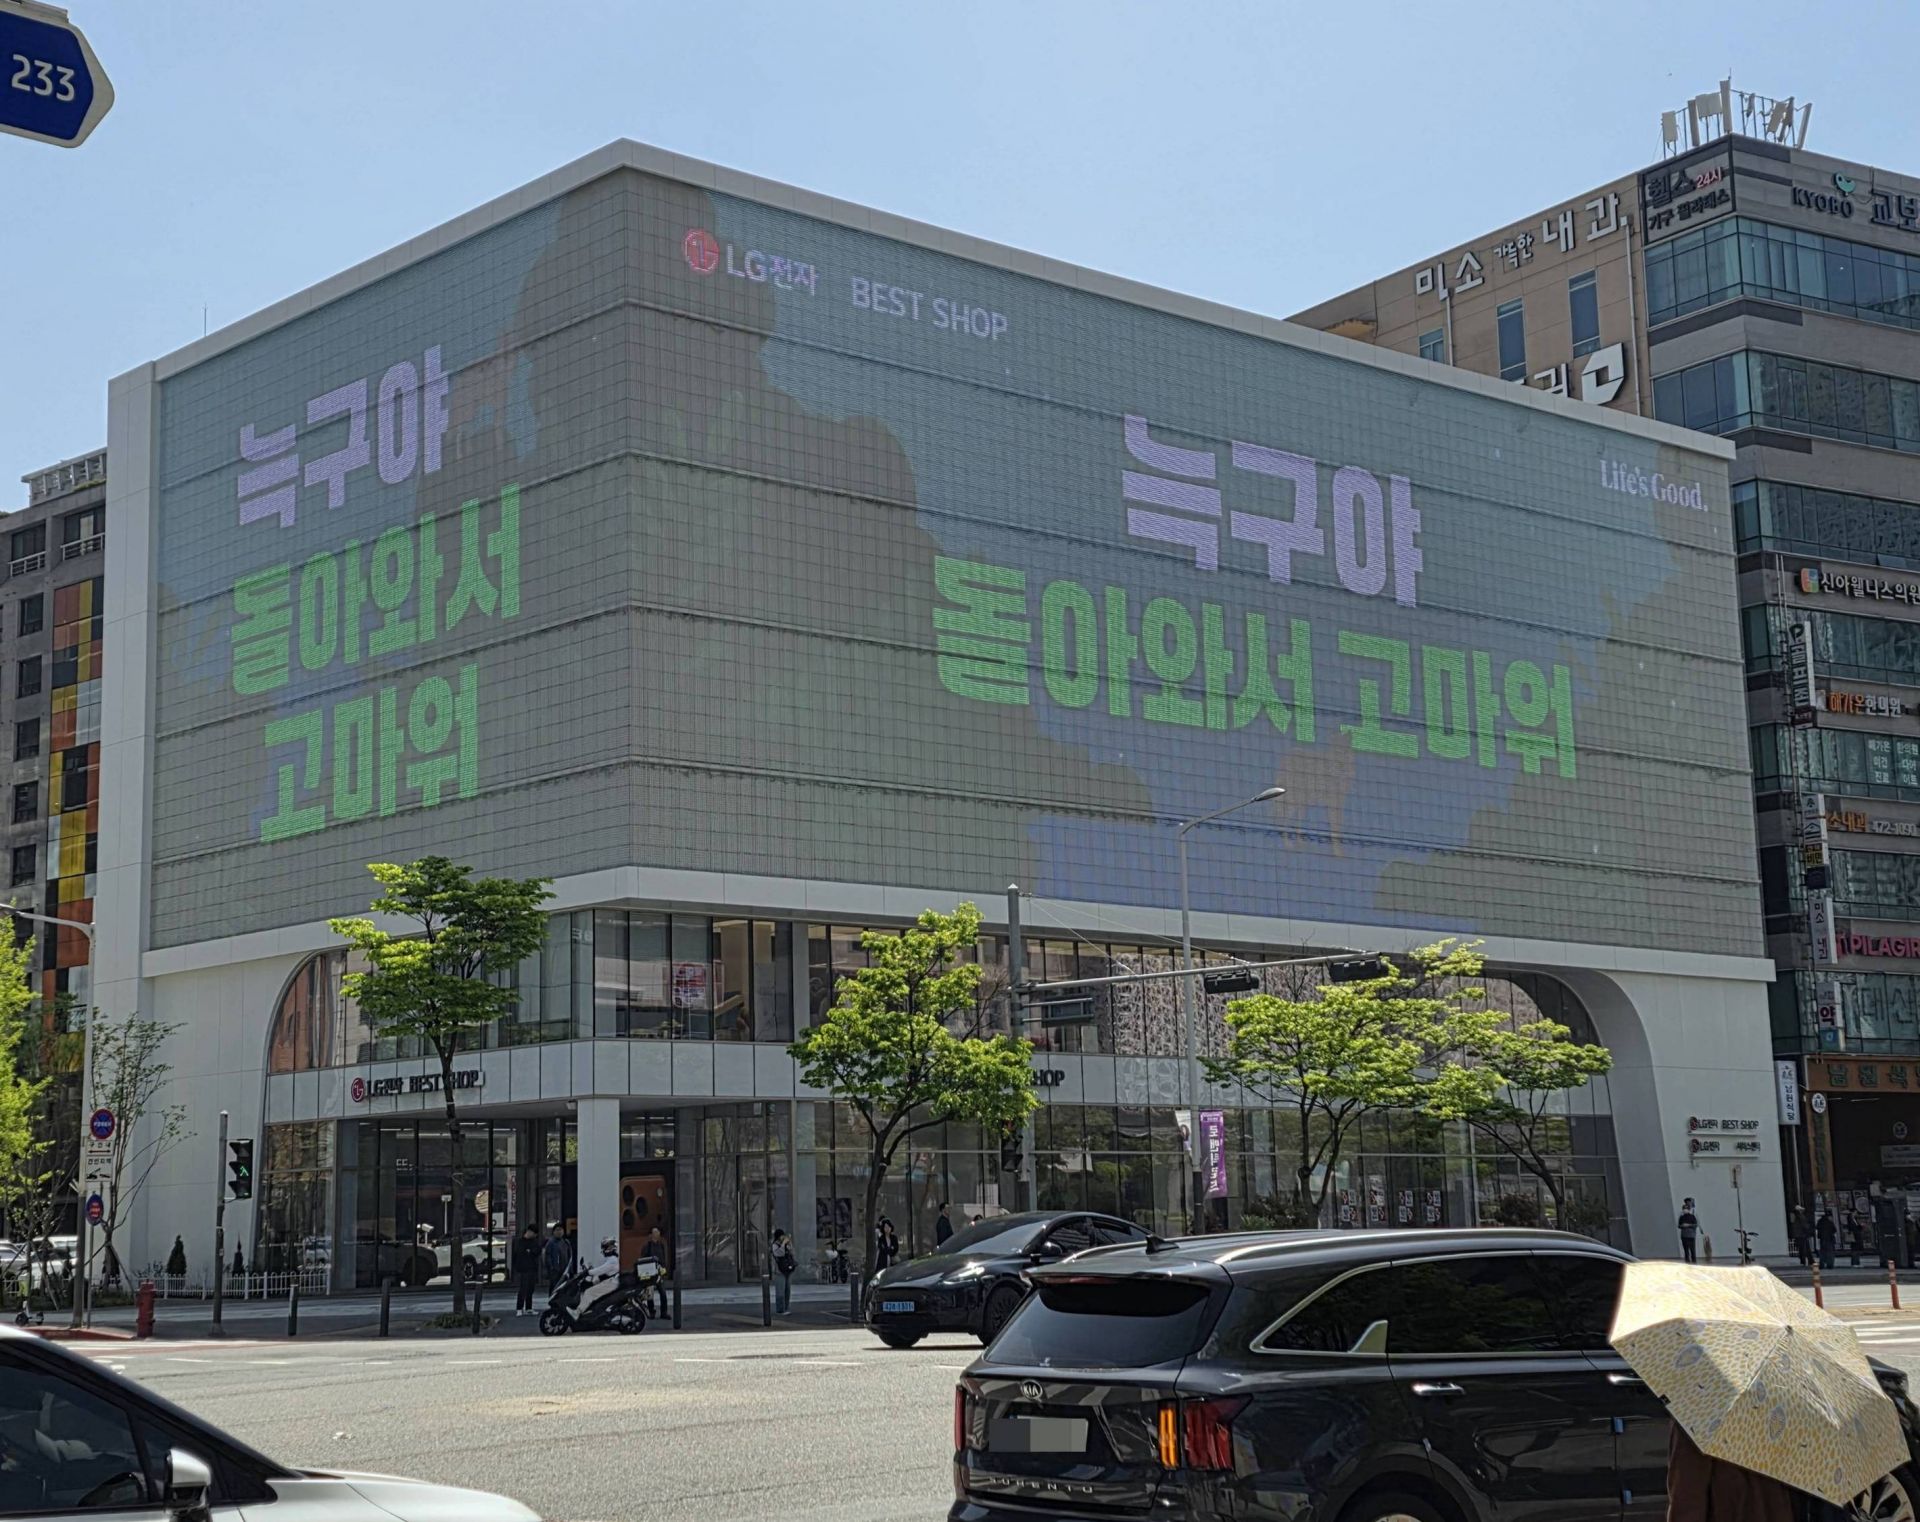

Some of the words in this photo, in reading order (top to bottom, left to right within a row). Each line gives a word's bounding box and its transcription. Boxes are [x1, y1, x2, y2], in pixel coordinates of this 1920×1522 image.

[12, 54, 75, 101] 233
[1696, 166, 1723, 189] 24시
[1648, 208, 1675, 231] 기구
[1677, 187, 1731, 221] 필라테스
[1792, 186, 1853, 218] KYOBO
[1415, 251, 1485, 301] 미소
[1494, 232, 1534, 268] 가득한
[1542, 192, 1620, 253] 내과
[726, 243, 820, 297] LG전자
[852, 276, 924, 322] BEST
[932, 297, 1008, 341] SHOP
[237, 343, 449, 528] 늑구야
[1601, 457, 1649, 498] Life's
[1651, 472, 1708, 513] Good.
[1122, 412, 1424, 609] 늑구야
[231, 481, 520, 696] 돌아와서
[1821, 572, 1920, 606] 신아웰니스의원
[931, 554, 1316, 743] 돌아와서
[1337, 628, 1577, 780] 고마워
[261, 662, 479, 843] 고마워
[1826, 810, 1869, 834] 소내과
[410, 1074, 443, 1093] BEST
[450, 1070, 479, 1088] HOP
[1032, 1069, 1065, 1087] HOP
[1827, 1062, 1920, 1088] 남원식
[1721, 1118, 1739, 1130] BEST
[1740, 1119, 1760, 1130] SHOP
[1023, 1384, 1040, 1399] KIA
